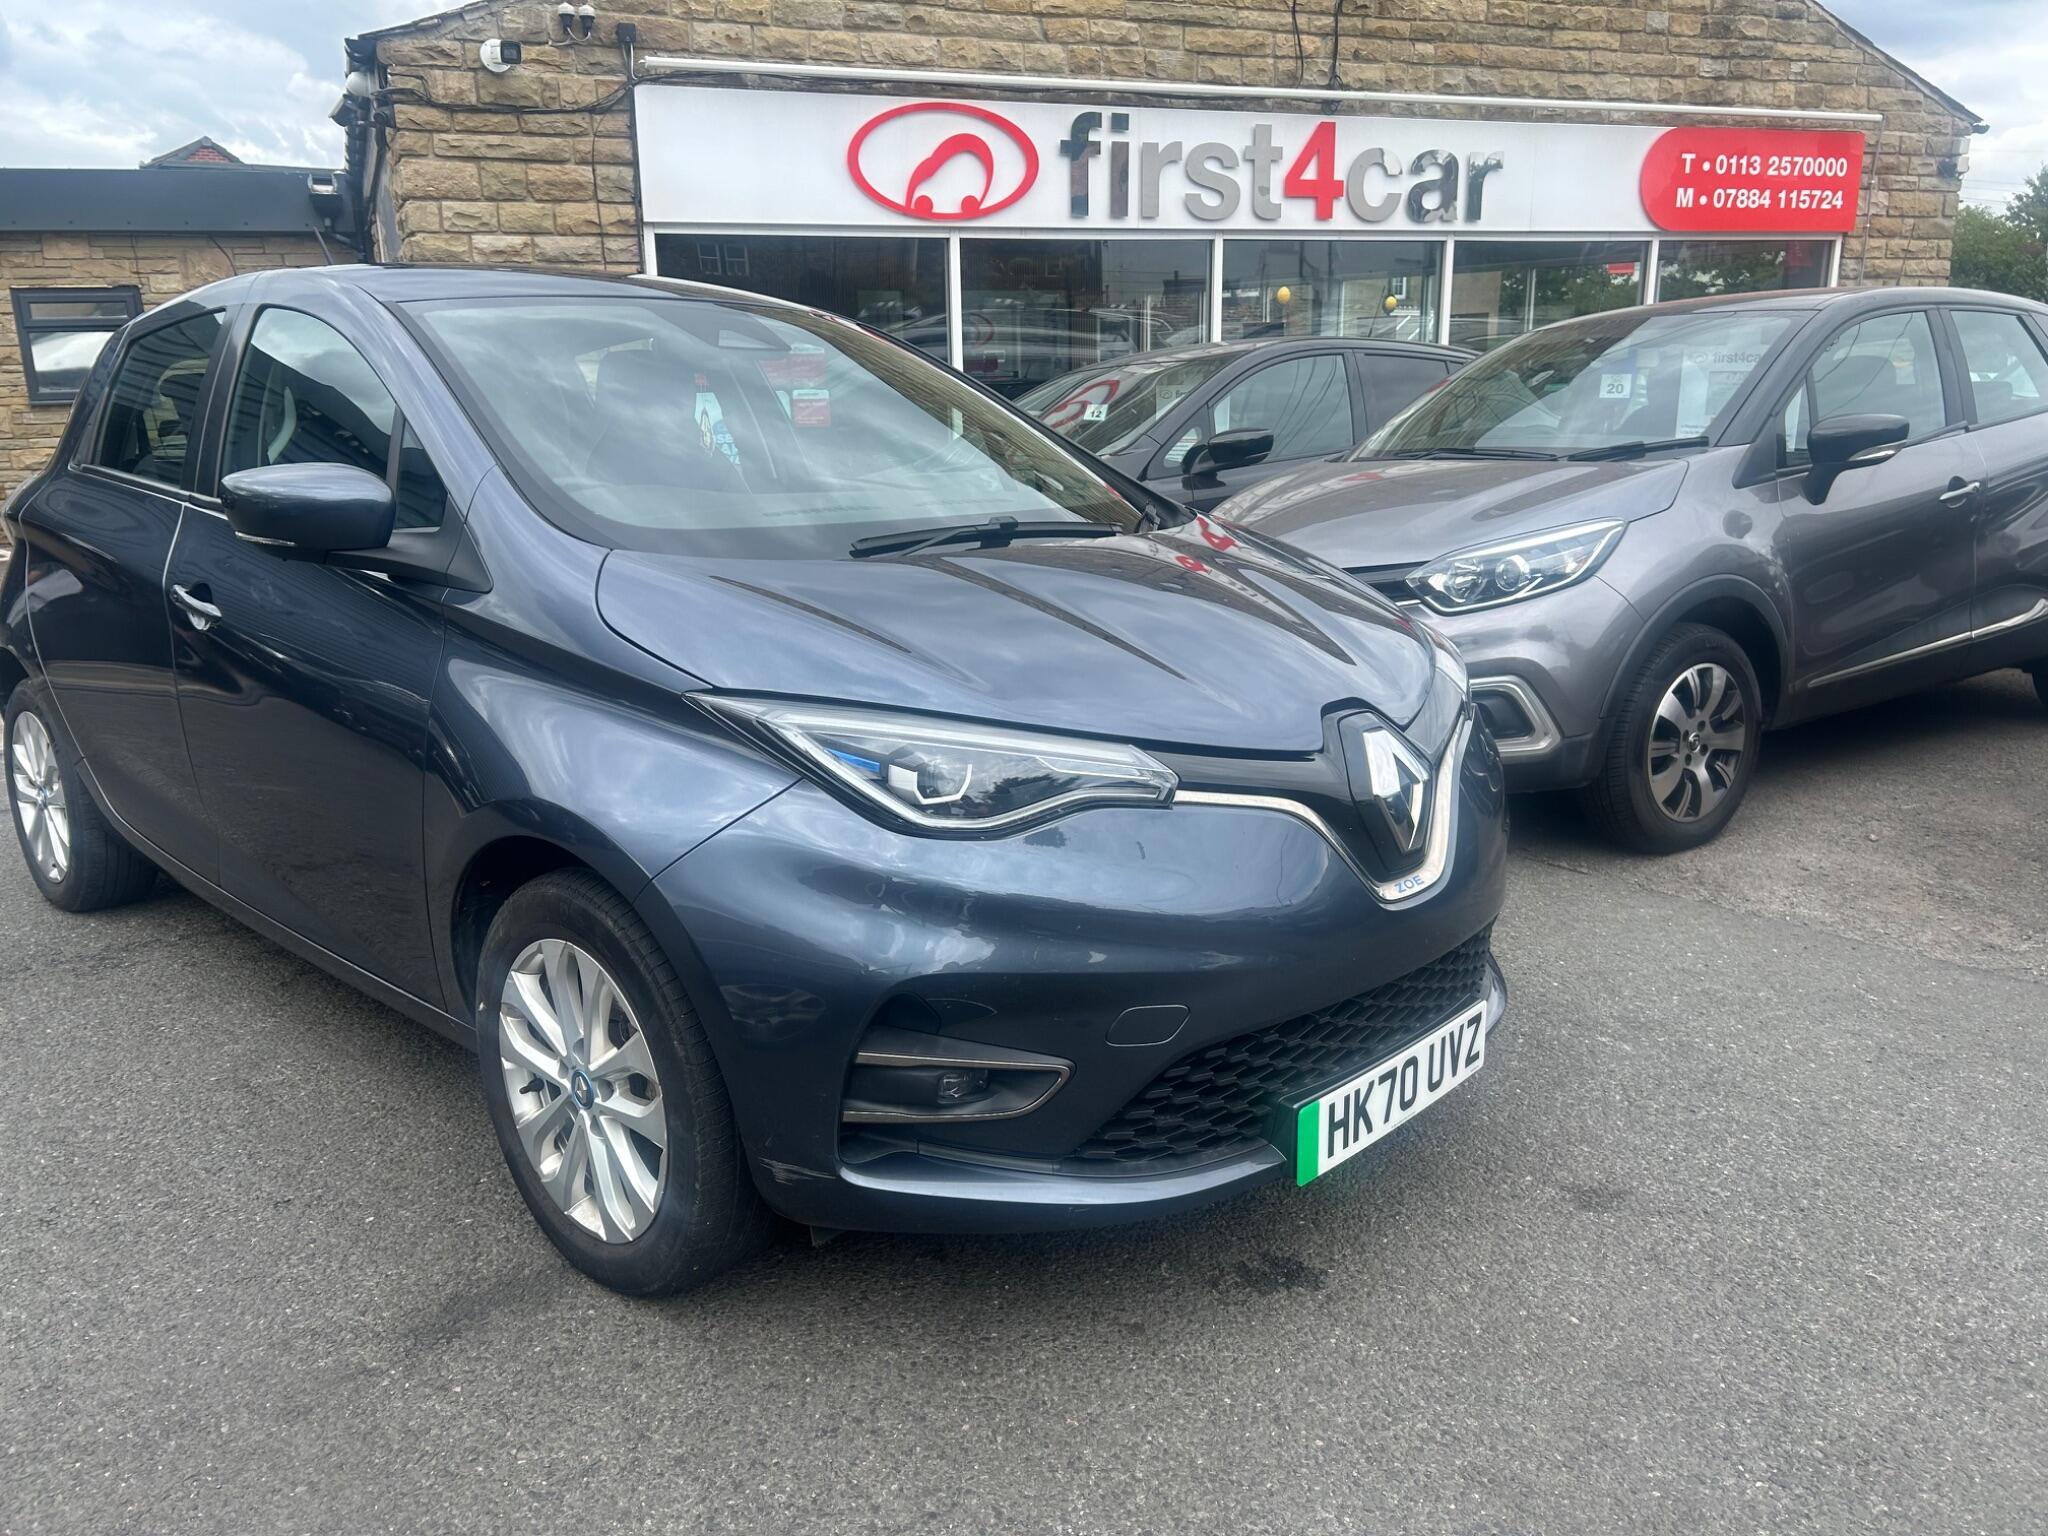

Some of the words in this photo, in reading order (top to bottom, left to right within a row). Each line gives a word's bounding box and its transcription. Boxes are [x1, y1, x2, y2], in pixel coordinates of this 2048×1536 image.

[1060, 111, 1504, 223] first4car
[1681, 153, 1696, 174] T
[1715, 154, 1761, 175] 0113
[1767, 156, 1847, 177] 2570000
[1676, 187, 1695, 208] M
[1713, 188, 1771, 208] 07884
[1778, 190, 1843, 209] 115724
[1713, 351, 1760, 364] first4ca
[1606, 383, 1624, 394] 20
[1090, 410, 1102, 418] 12
[1395, 875, 1424, 893] ZOE
[1327, 1055, 1418, 1159] HK70
[1427, 1011, 1482, 1093] UVZ
